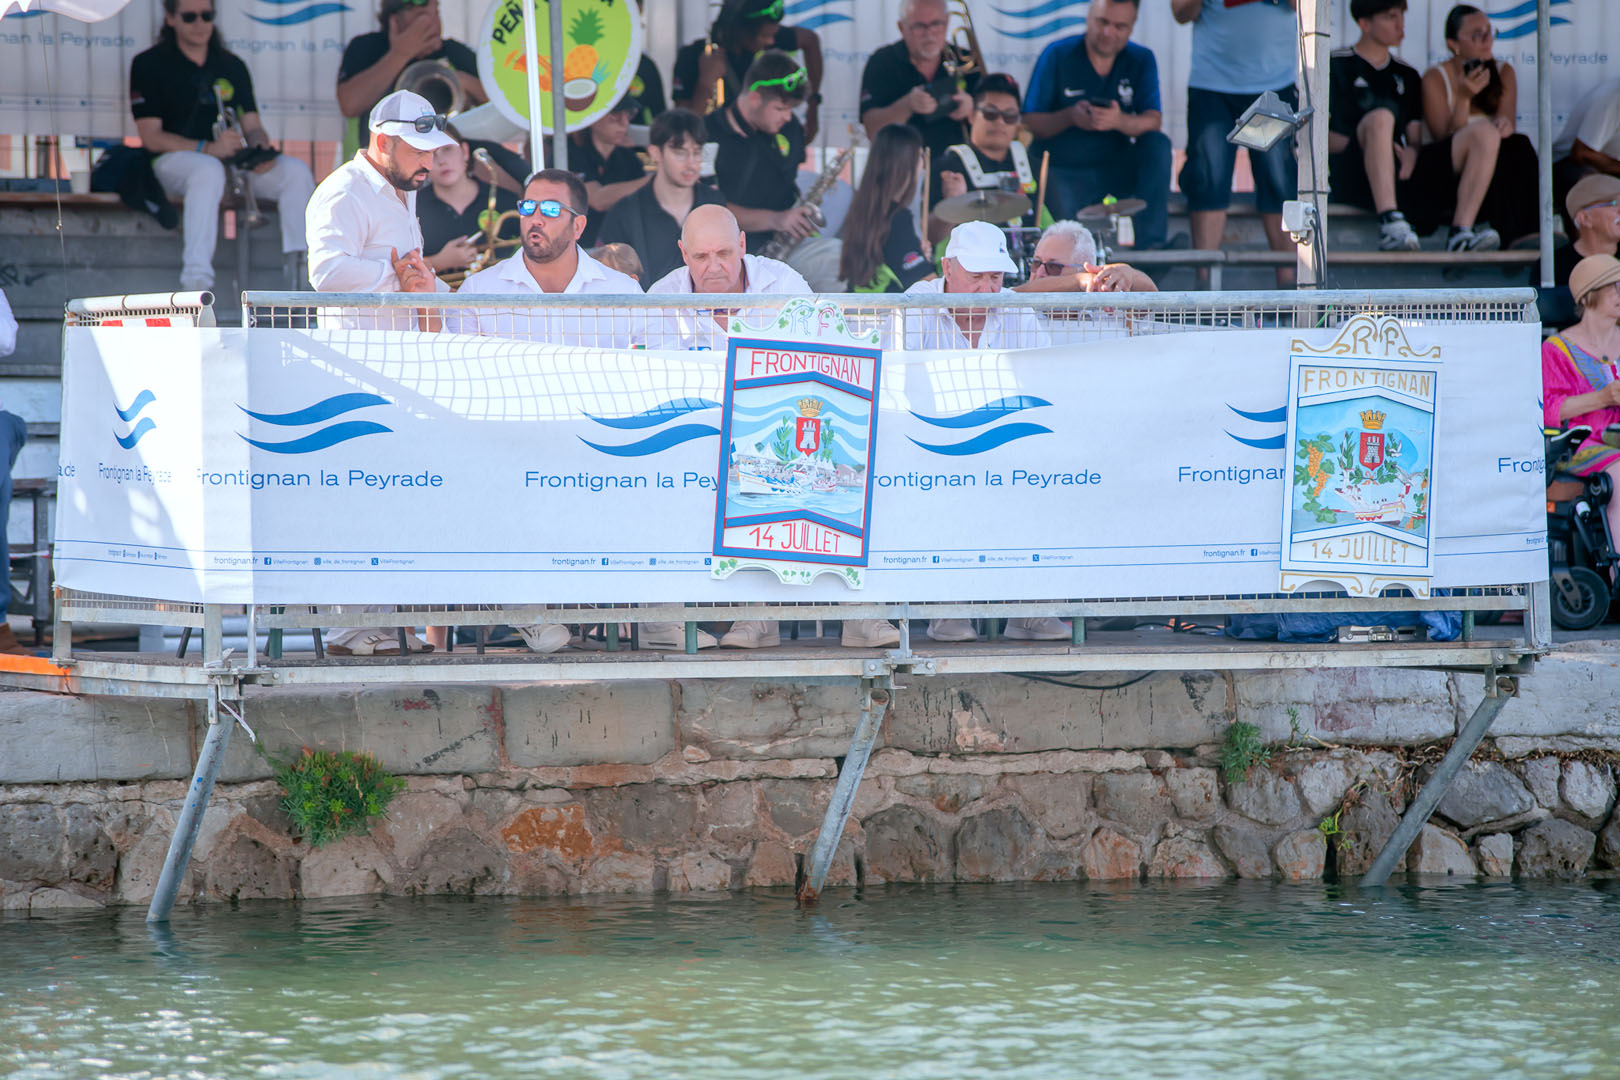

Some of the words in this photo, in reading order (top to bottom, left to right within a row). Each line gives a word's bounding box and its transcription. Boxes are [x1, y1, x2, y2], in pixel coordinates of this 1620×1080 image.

[1550, 52, 1609, 67] eyrade
[751, 351, 861, 385] FRONTIGNAN
[1304, 370, 1430, 397] FRONTIGNAN
[320, 469, 340, 487] la
[348, 469, 443, 490] Peyrade
[525, 471, 647, 492] Frontignan
[656, 471, 675, 489] la
[985, 470, 1002, 486] la
[1012, 469, 1101, 489] Peyrade
[749, 525, 774, 548] 14
[781, 522, 841, 553] JUILLET
[1203, 548, 1246, 559] frontignan.fr
[1312, 541, 1333, 559] 14
[1338, 535, 1409, 563] JUILLET
[214, 556, 259, 566] frontignan.fr
[552, 557, 596, 567] frontignan.fr
[883, 555, 928, 565] frontignan.fr
